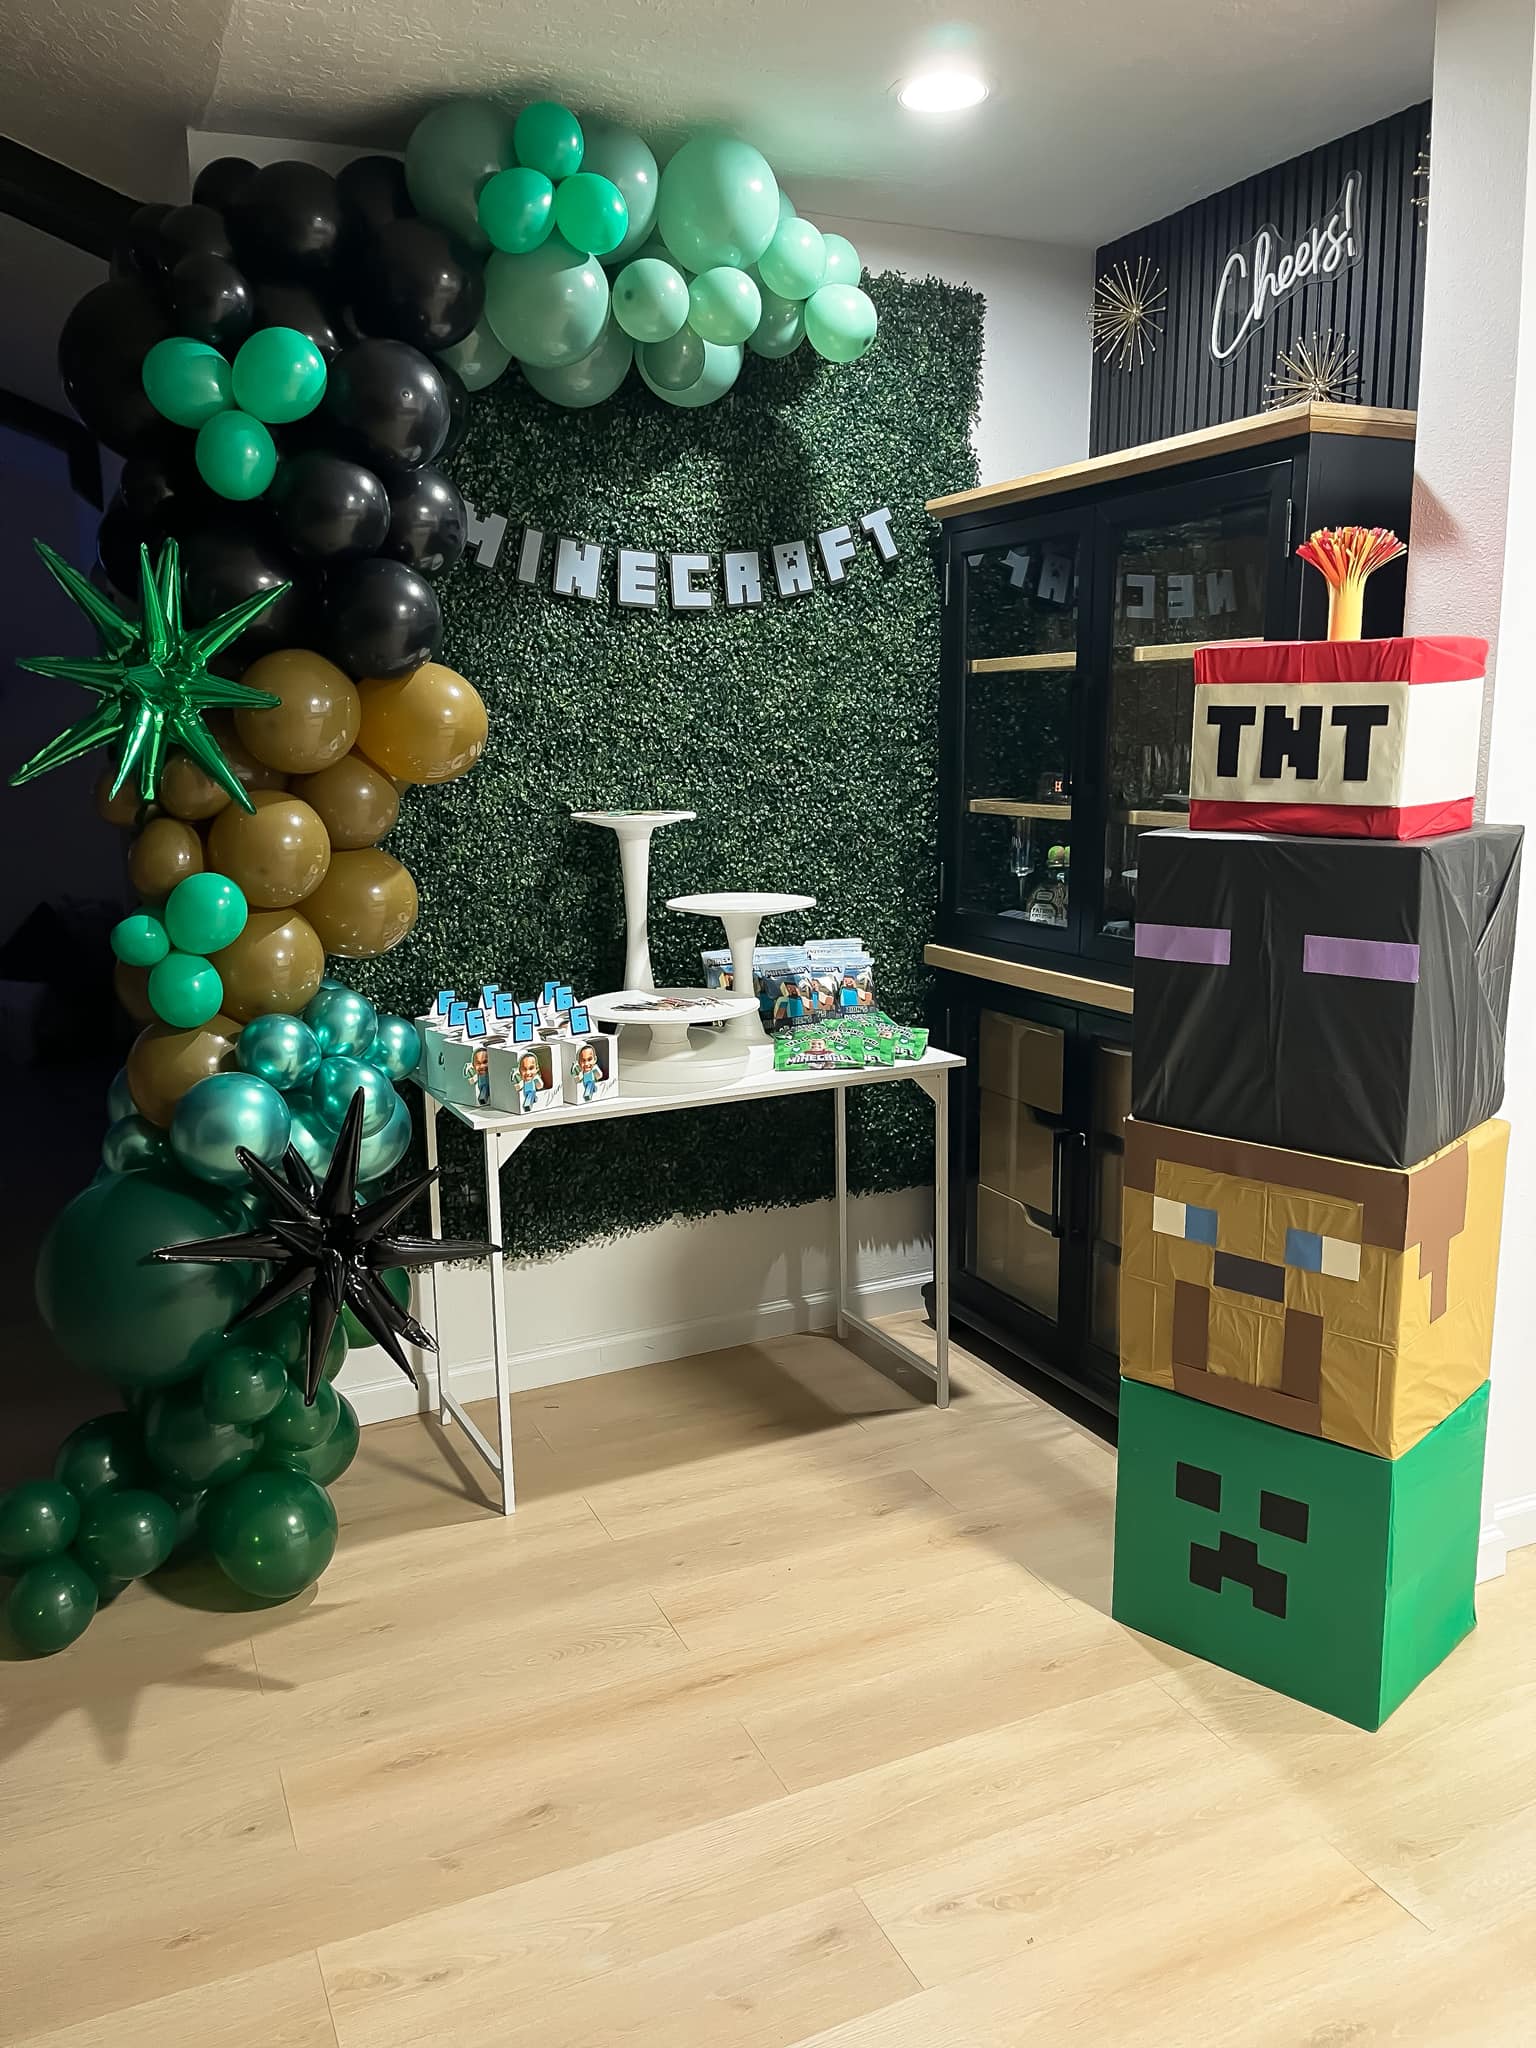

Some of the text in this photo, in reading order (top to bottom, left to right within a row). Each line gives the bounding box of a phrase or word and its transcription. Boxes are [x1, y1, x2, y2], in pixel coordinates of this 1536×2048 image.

[1211, 179, 1355, 359] Cheers!
[465, 500, 899, 610] MINECRAFT
[1207, 705, 1389, 781] TNT
[494, 992, 515, 1019] 6
[555, 985, 575, 1012] 6
[465, 1008, 487, 1038] 6
[513, 1014, 533, 1043] 6
[568, 1005, 591, 1035] 6
